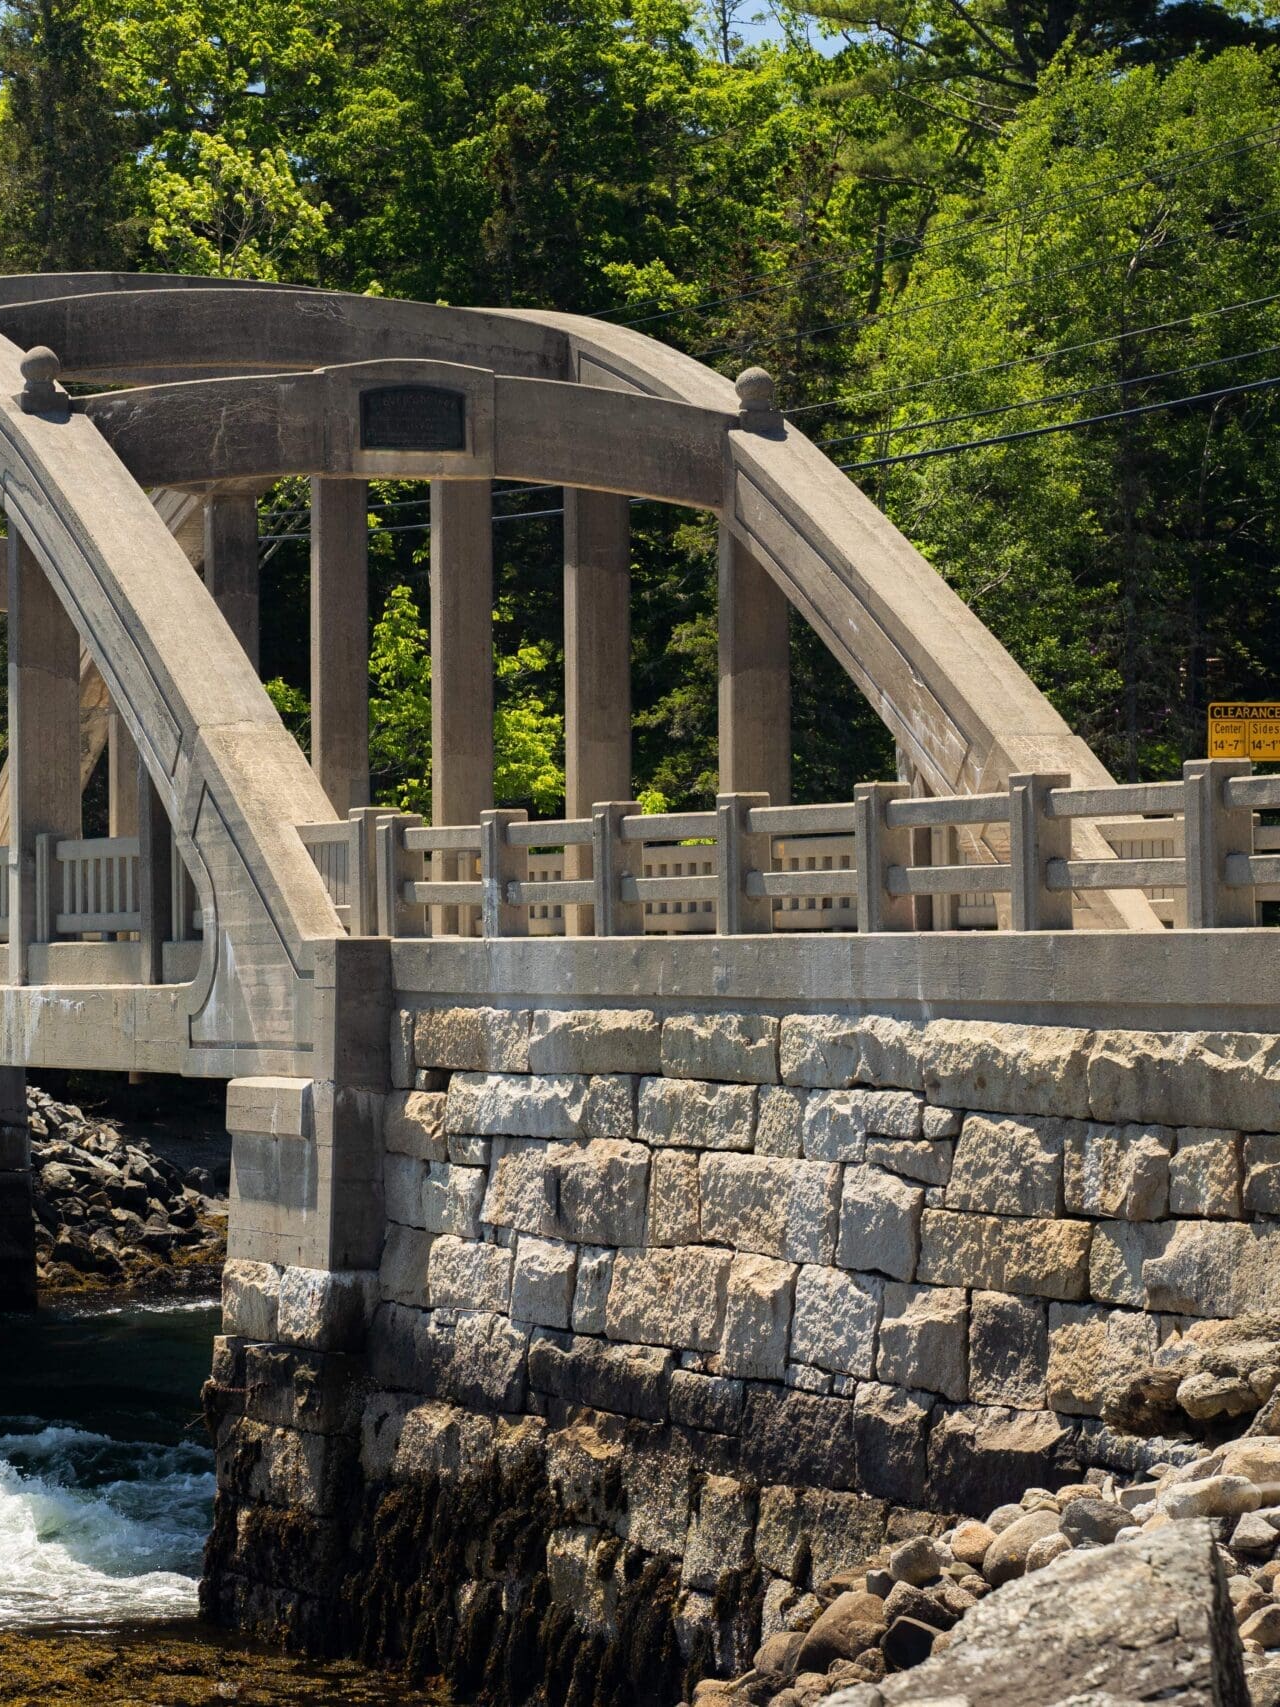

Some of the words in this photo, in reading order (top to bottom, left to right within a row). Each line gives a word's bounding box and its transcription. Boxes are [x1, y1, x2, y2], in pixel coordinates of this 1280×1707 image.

[1214, 707, 1280, 718] CLEARANCE
[1215, 723, 1241, 734] Center
[1252, 723, 1280, 734] Sides
